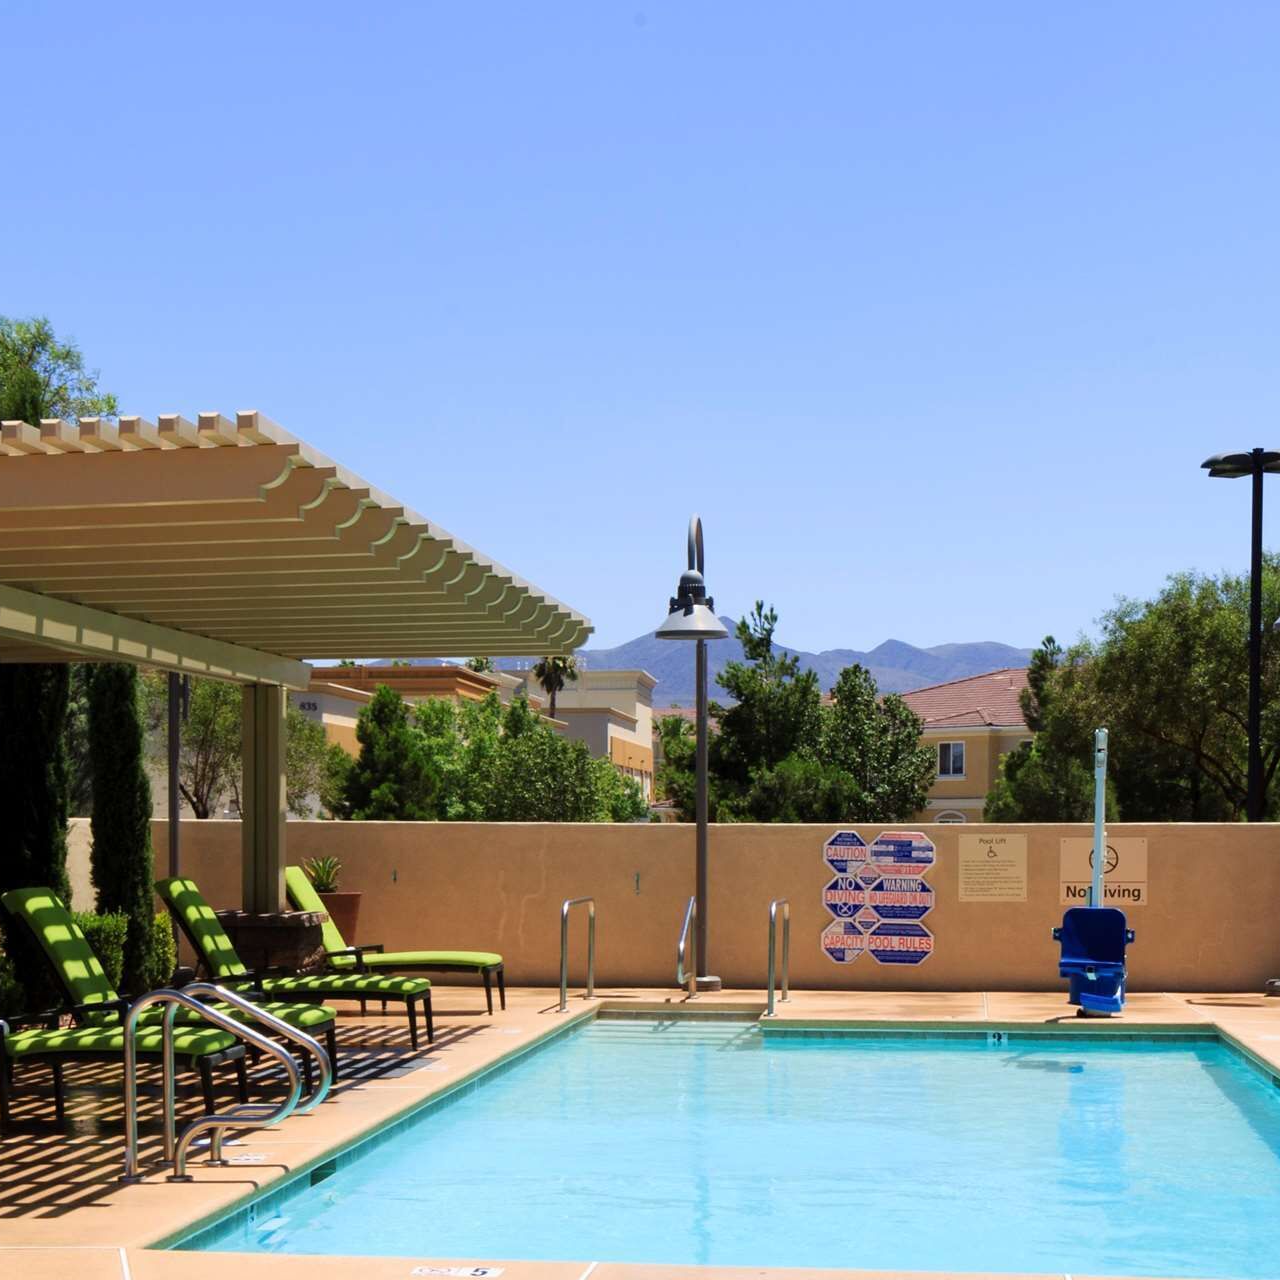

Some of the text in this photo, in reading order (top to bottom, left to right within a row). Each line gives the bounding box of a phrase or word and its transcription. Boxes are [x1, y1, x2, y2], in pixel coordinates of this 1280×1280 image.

[826, 847, 866, 858] CAUTION
[837, 879, 855, 890] NO
[883, 880, 922, 892] WARNING
[825, 891, 864, 903] DIVING
[1066, 885, 1141, 901] No iving
[823, 936, 865, 947] CAPACITY
[868, 938, 932, 950] POOL RULES
[470, 1268, 489, 1276] 5
